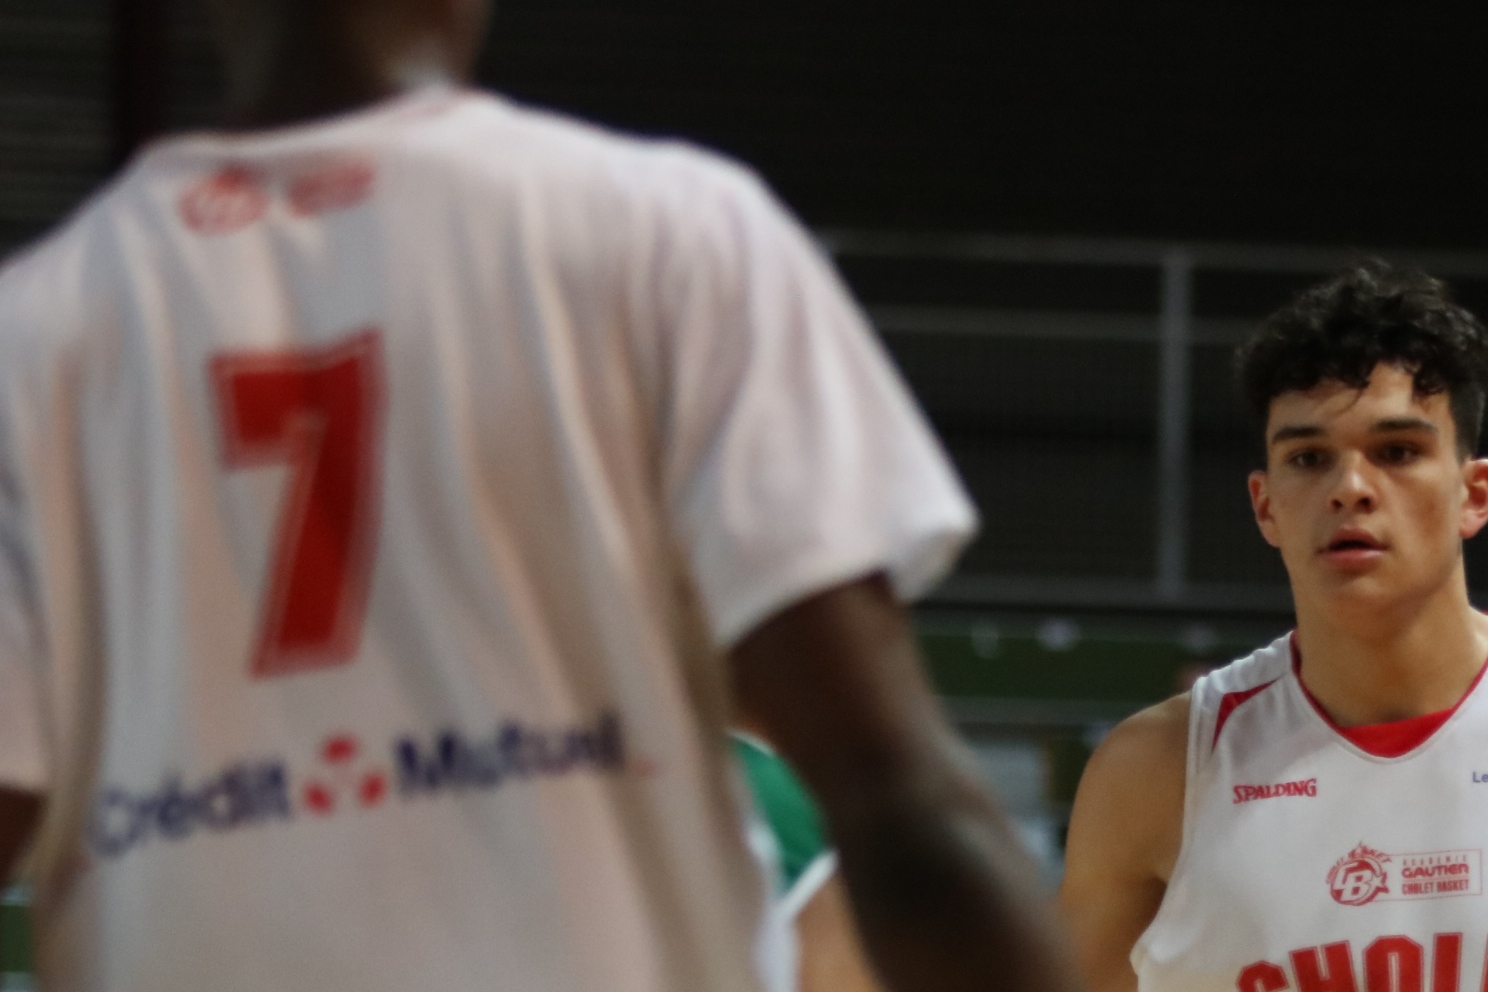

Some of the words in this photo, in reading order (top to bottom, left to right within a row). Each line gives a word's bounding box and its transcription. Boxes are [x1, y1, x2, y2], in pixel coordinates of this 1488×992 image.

[208, 326, 386, 682] 7
[1232, 778, 1317, 804] SPALDING
[1402, 863, 1469, 879] GAUTIER
[1402, 882, 1435, 896] CHOLET
[1437, 879, 1469, 893] BASKET
